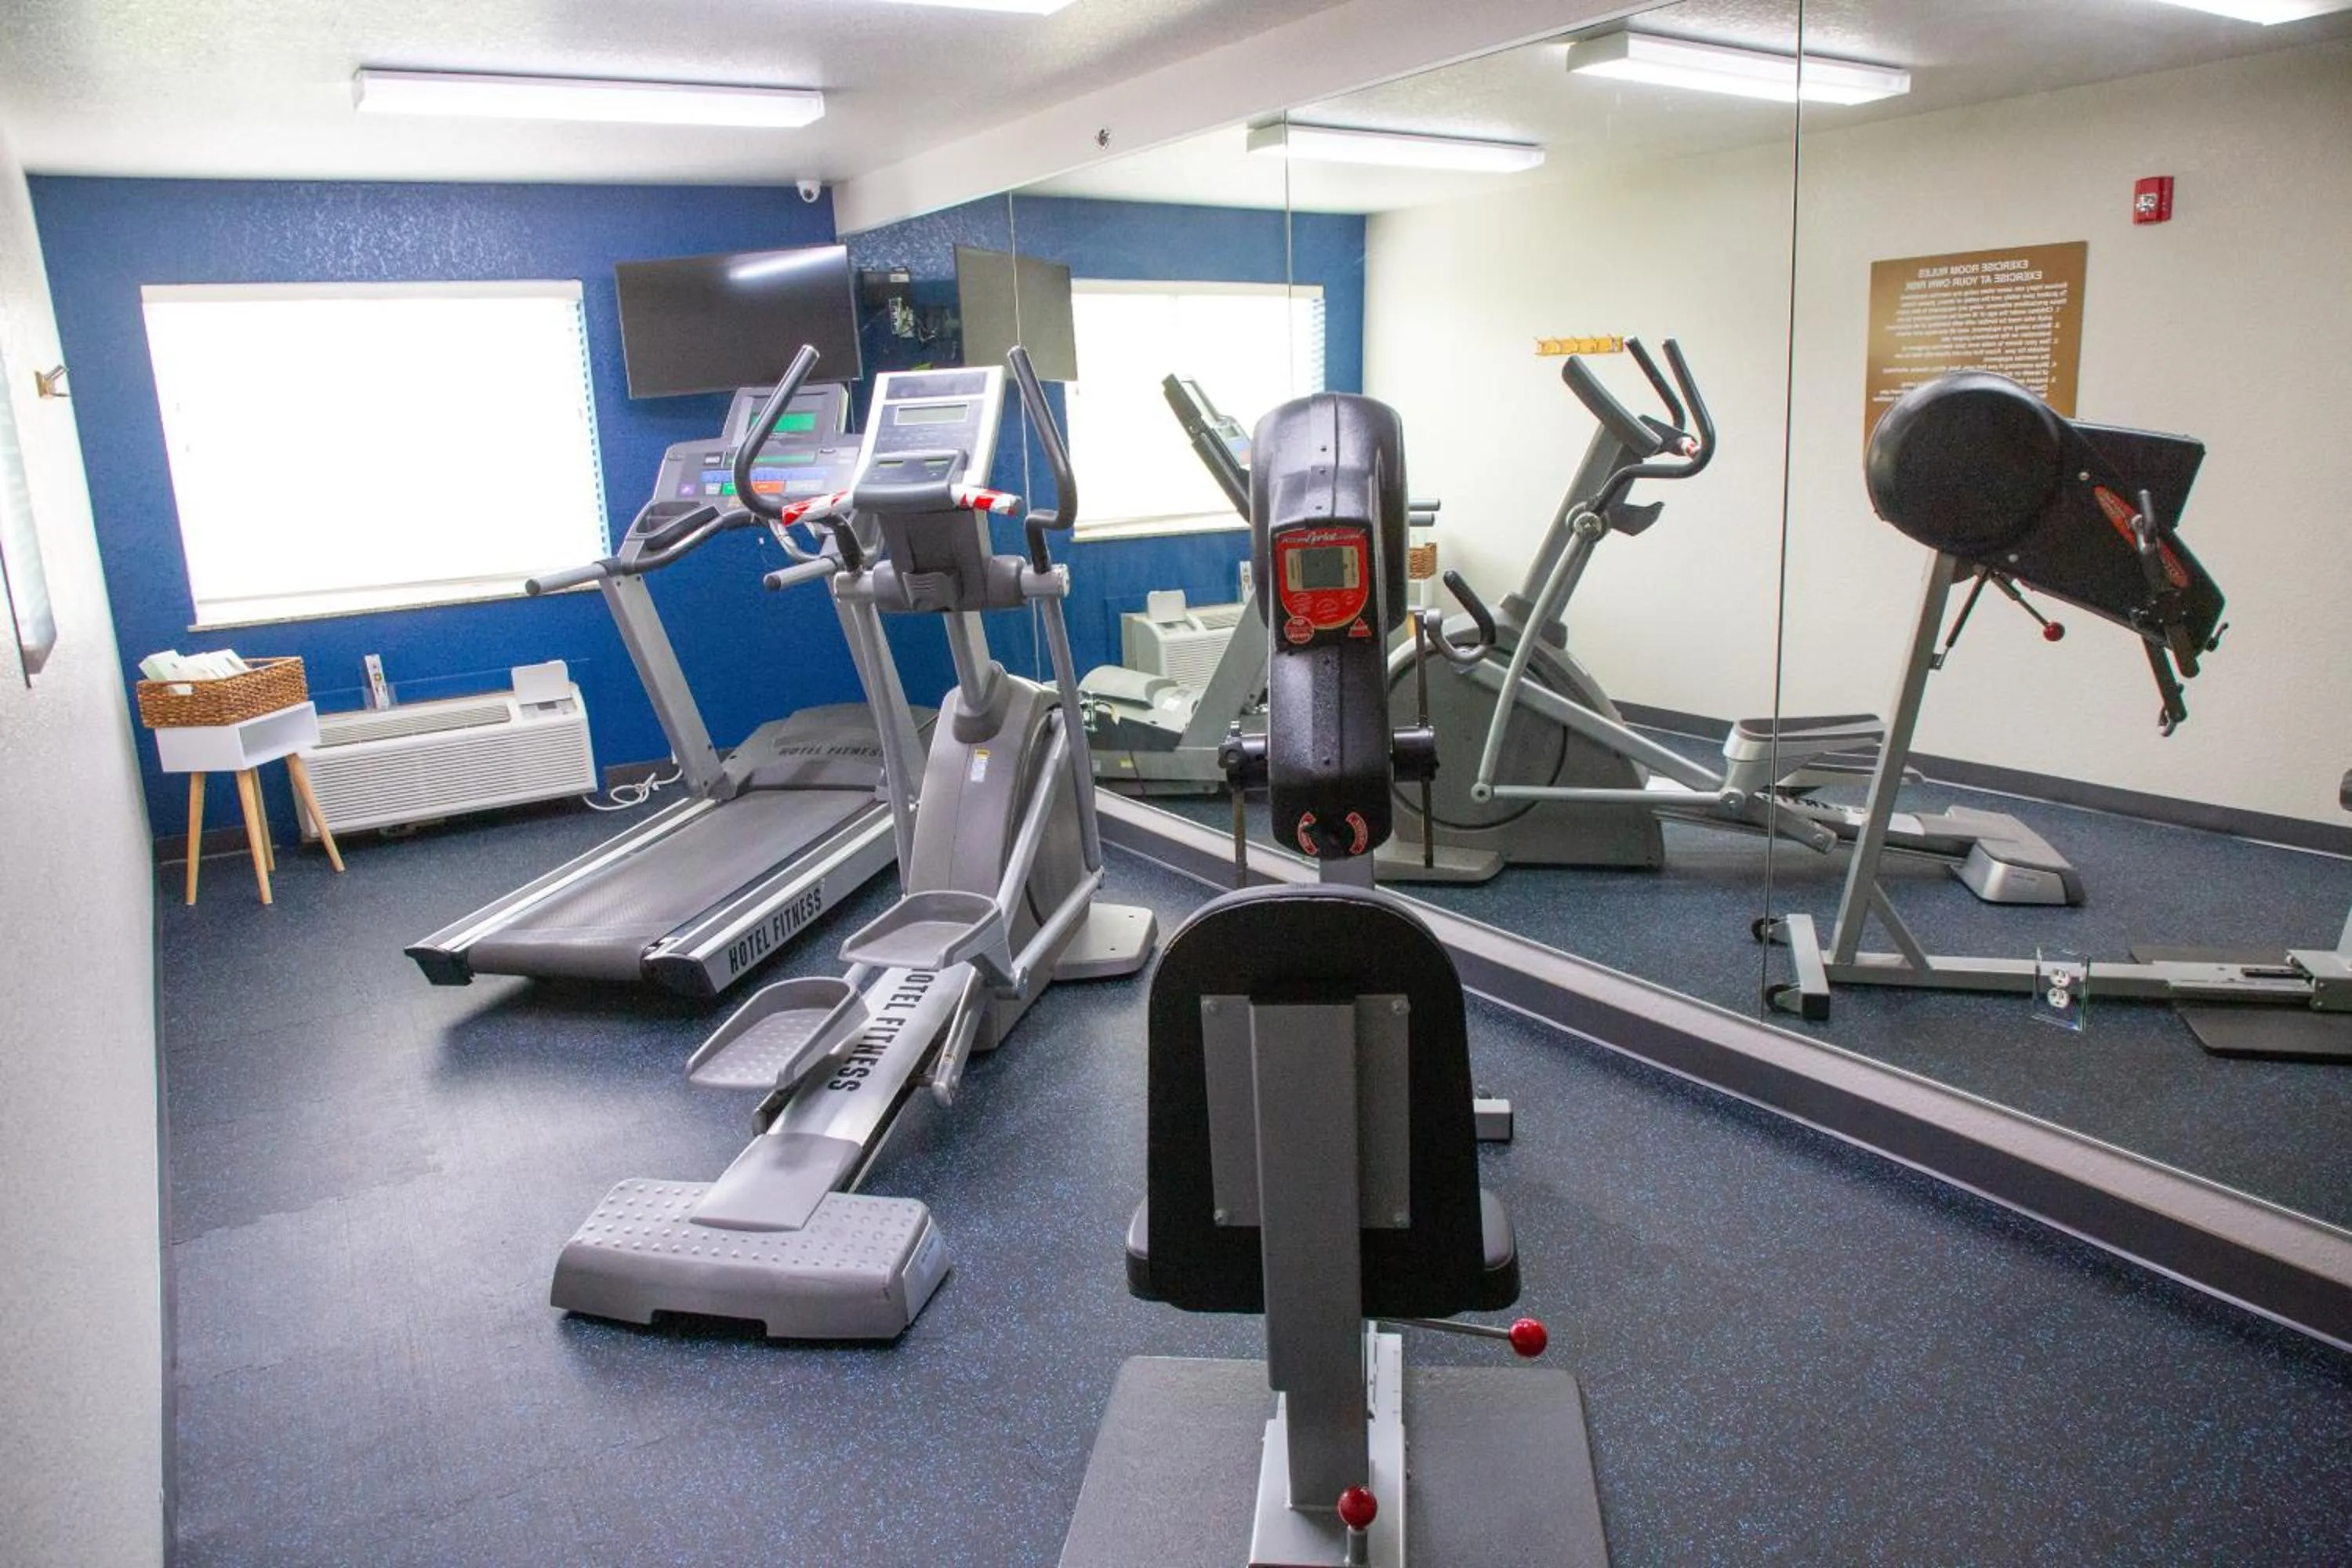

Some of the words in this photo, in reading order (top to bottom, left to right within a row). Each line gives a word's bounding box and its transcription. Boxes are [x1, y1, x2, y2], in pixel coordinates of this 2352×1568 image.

[779, 746, 823, 756] HOTEL
[728, 925, 771, 974] HOTEL
[772, 888, 822, 942] FITNESS
[827, 1017, 907, 1092] FITNESS
